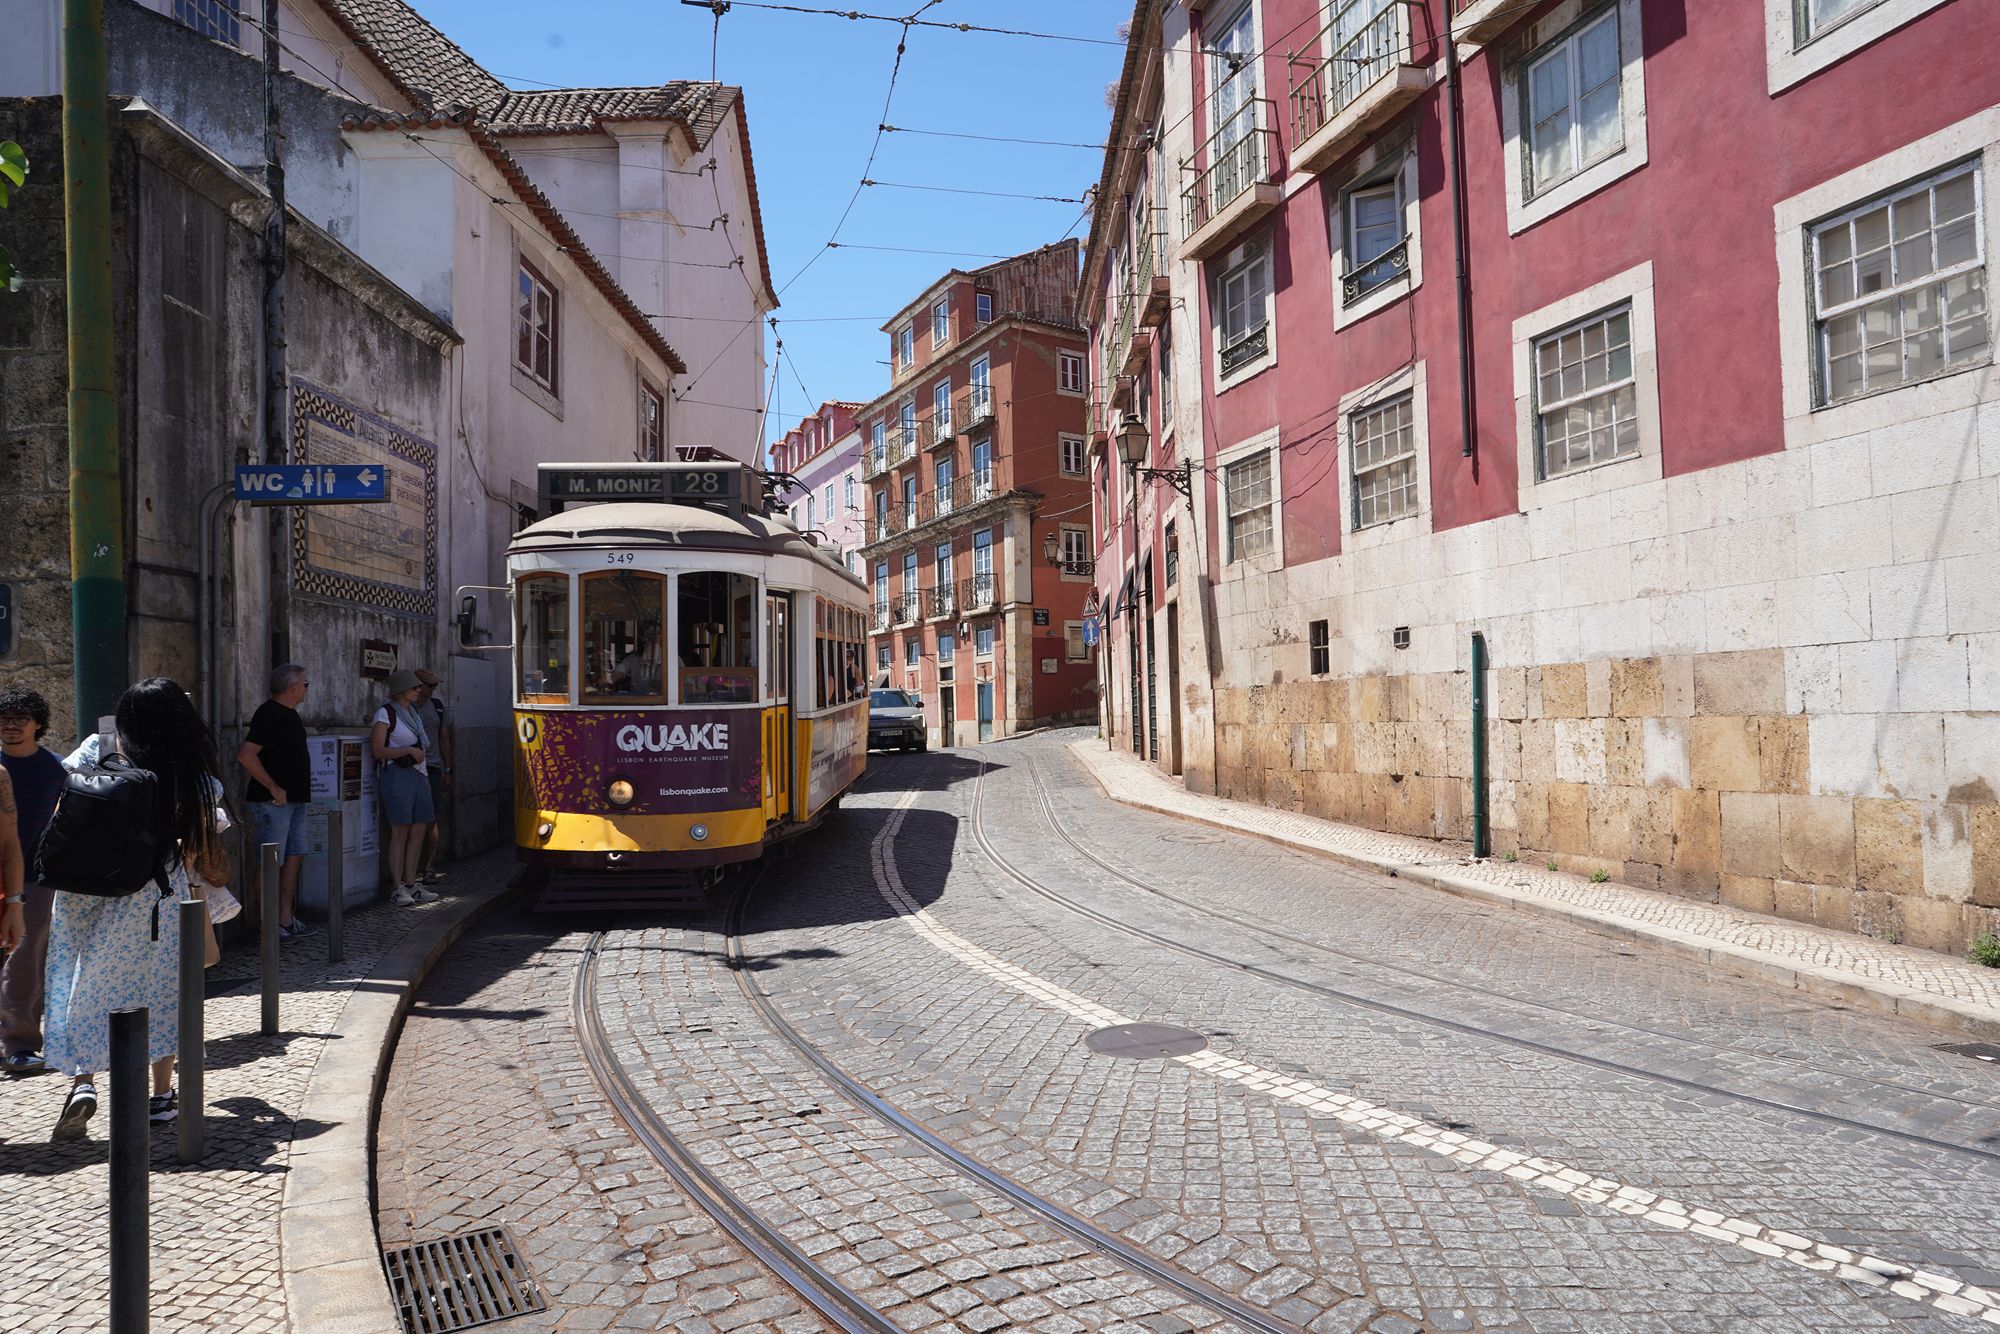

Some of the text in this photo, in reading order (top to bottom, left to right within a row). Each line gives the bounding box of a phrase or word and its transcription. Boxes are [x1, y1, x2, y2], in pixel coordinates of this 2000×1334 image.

[240, 473, 284, 492] WC
[569, 478, 663, 493] M. MONIZ
[685, 472, 719, 493] 28
[608, 553, 634, 564] 549
[616, 723, 729, 753] QUAKE
[660, 786, 729, 797] lisbonquake.com
